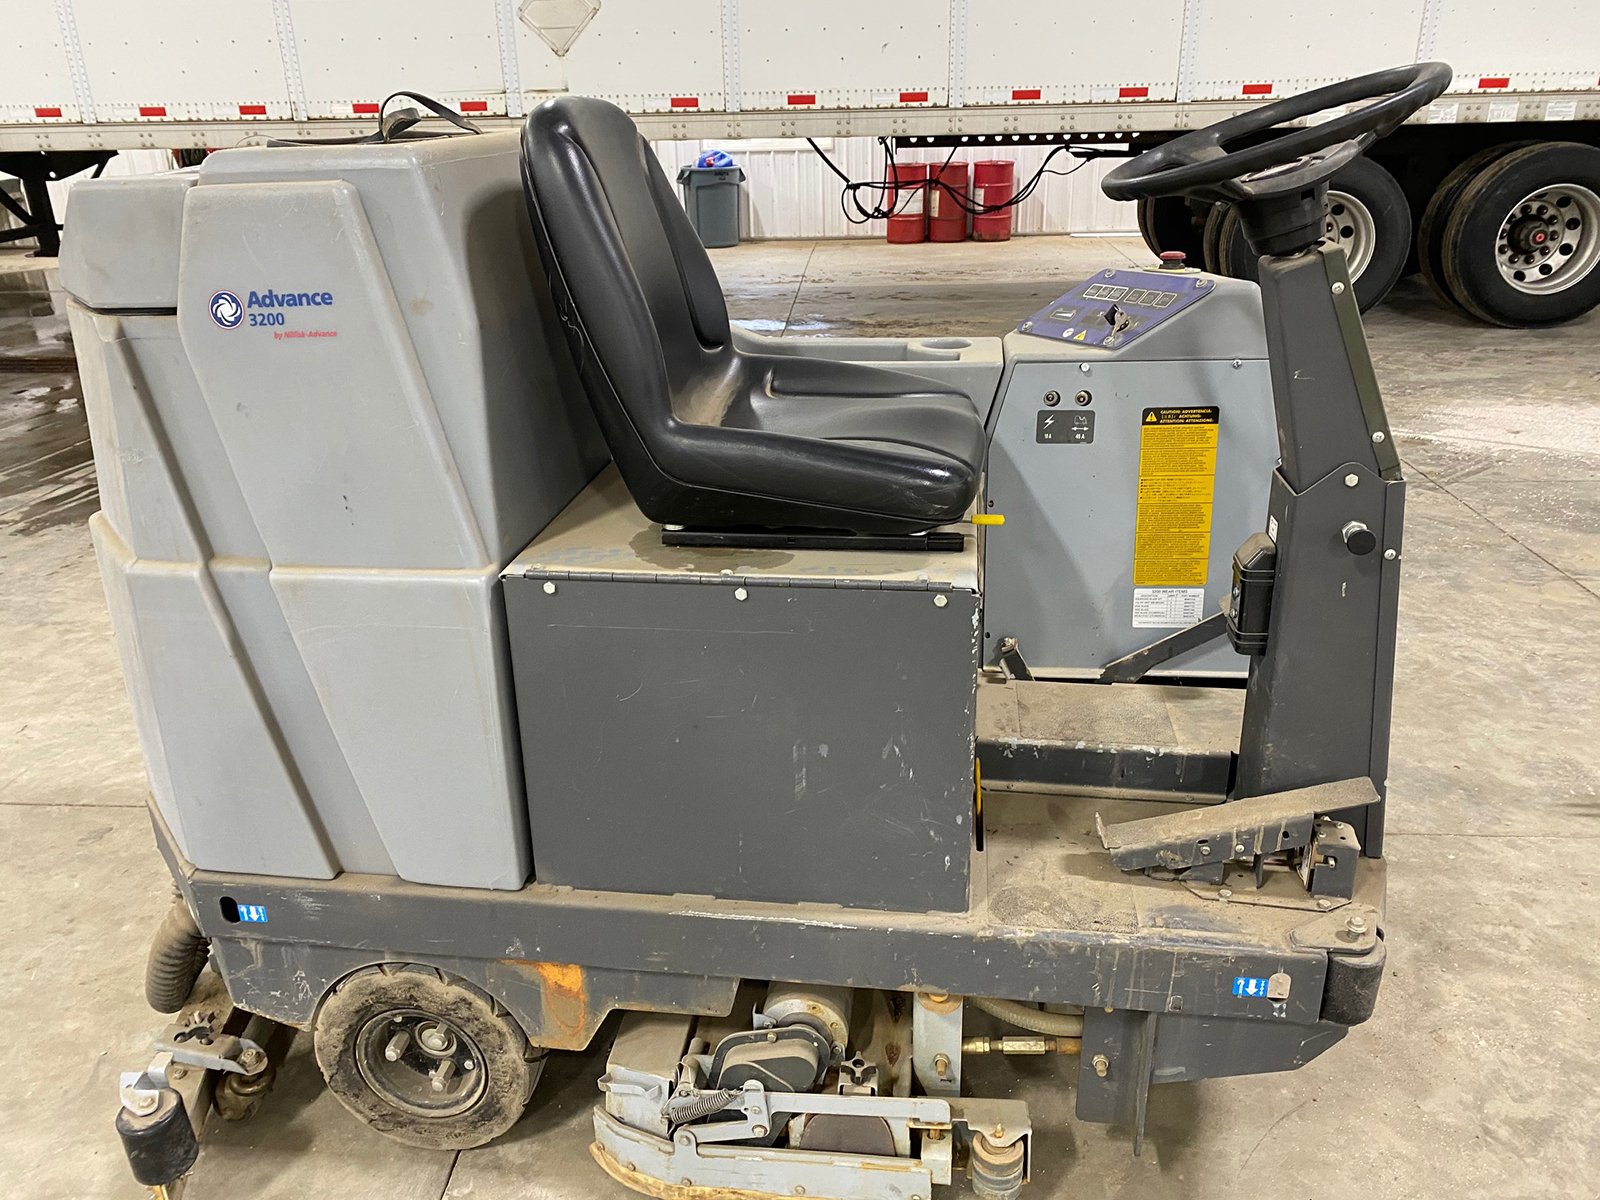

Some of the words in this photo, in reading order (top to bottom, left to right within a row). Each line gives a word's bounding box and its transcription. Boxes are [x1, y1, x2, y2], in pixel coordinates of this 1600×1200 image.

[247, 289, 333, 308] Advance
[248, 312, 285, 327] 3200
[273, 331, 282, 340] by
